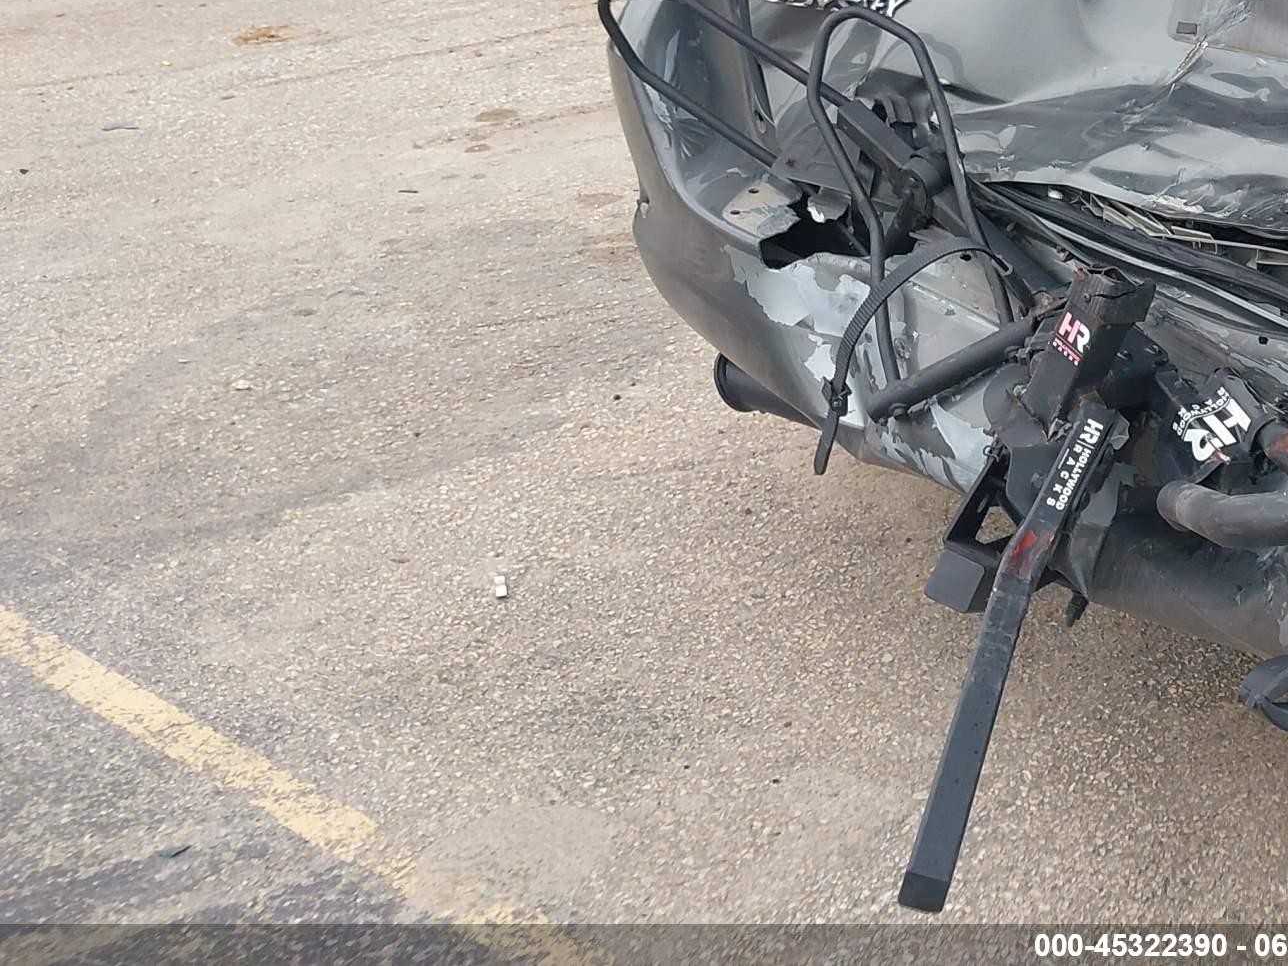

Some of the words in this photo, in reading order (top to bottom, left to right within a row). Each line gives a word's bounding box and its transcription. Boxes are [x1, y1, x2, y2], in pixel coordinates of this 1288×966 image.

[1058, 311, 1091, 354] HR
[1079, 418, 1104, 445] HR
[1175, 391, 1230, 437] HOLLYWOOD
[1183, 397, 1252, 462] HR
[1055, 447, 1092, 511] HOLLYWOOD
